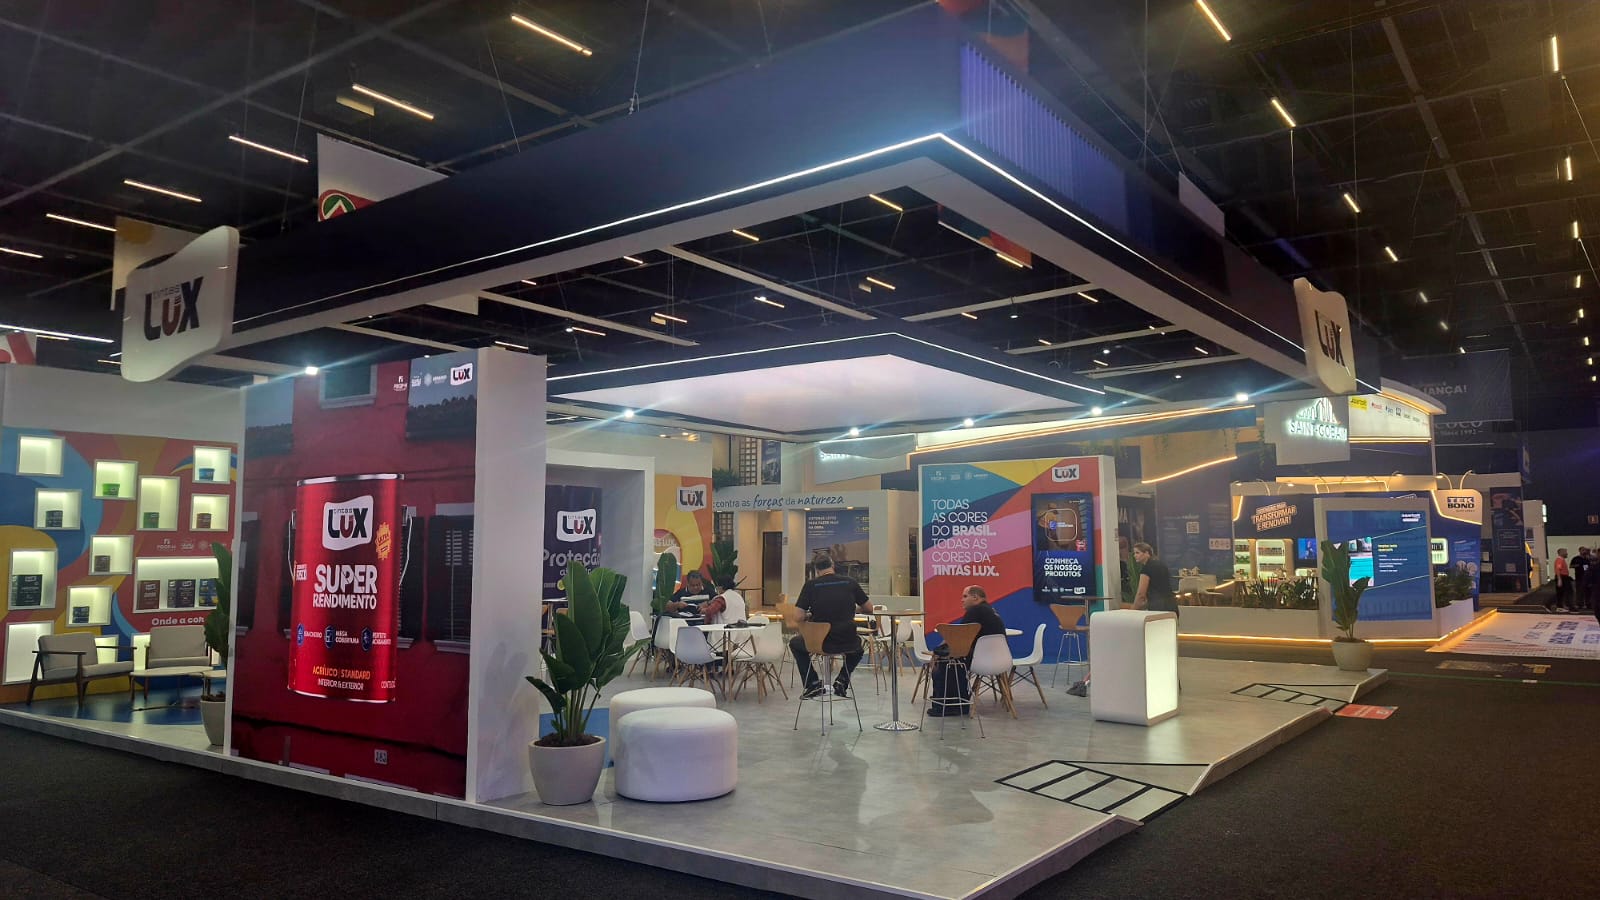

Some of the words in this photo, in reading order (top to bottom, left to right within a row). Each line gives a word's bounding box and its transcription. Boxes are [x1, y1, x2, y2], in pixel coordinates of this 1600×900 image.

[144, 276, 204, 341] LUX
[1315, 309, 1346, 367] LUX
[453, 367, 470, 381] LUX
[1054, 468, 1077, 479] LUX
[680, 490, 704, 507] LUX
[753, 494, 784, 509] forças
[797, 495, 845, 505] natureza
[932, 499, 970, 510] TODAS
[932, 512, 946, 523] AS
[948, 511, 988, 523] CORES
[1251, 504, 1297, 525] TRANSFORMAR
[328, 507, 369, 539] LUX
[563, 516, 594, 534] LUX
[932, 525, 950, 536] DO
[952, 524, 997, 536] BRASIL.
[932, 538, 970, 550] TODAS
[972, 538, 988, 549] AS
[543, 548, 600, 567] Proteçã
[932, 551, 972, 563] CORES
[973, 551, 991, 563] DA
[932, 564, 971, 576] TINTAS
[972, 565, 1000, 577] LUX.
[314, 564, 378, 593] SUPER
[313, 593, 377, 610] RENDIMENTO
[151, 617, 178, 626] Onde
[312, 664, 338, 677] ACRÍLICO
[340, 669, 371, 680] STANDARD
